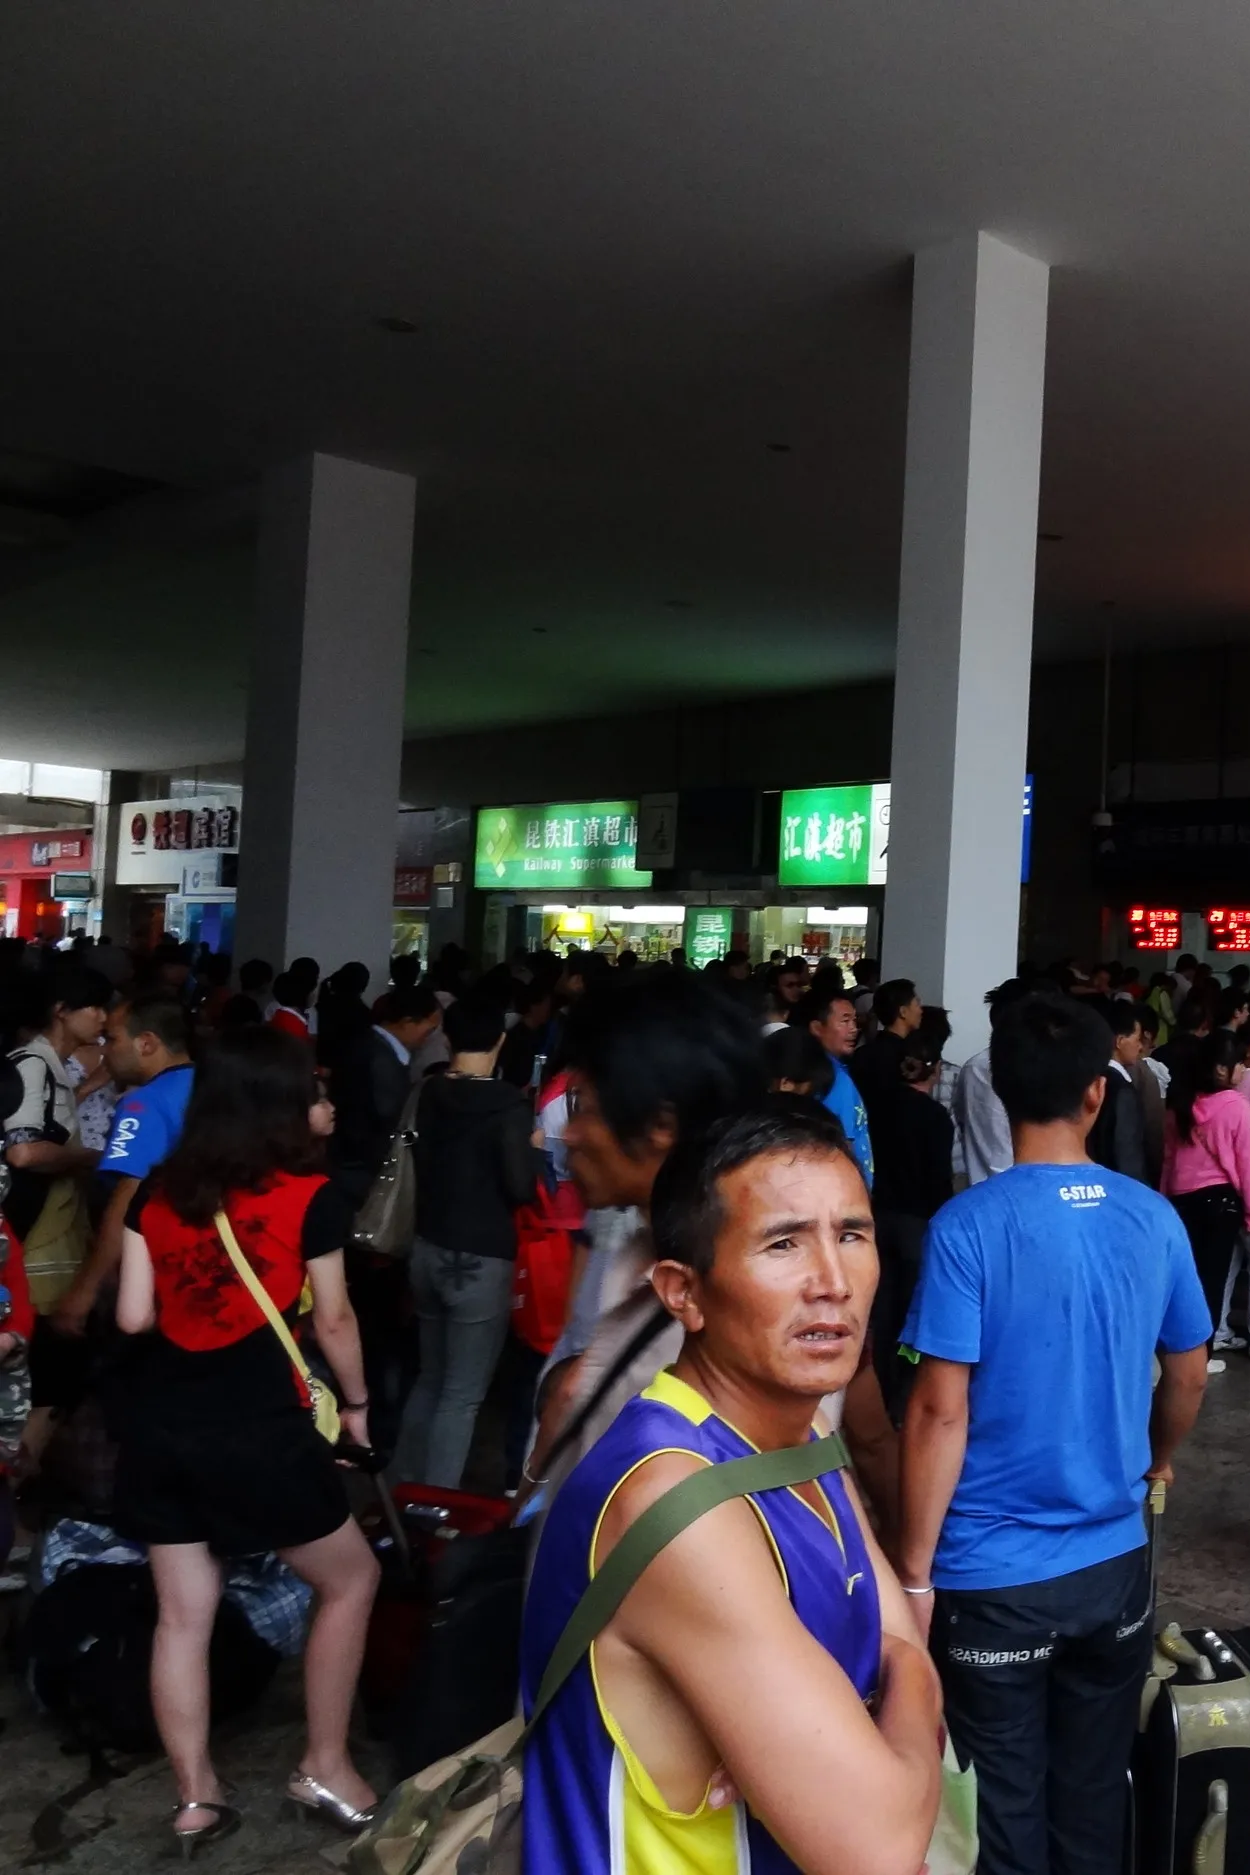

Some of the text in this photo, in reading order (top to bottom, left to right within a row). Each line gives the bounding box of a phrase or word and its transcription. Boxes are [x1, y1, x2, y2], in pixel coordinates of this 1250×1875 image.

[525, 816, 638, 848] 昆铁汇滇超市
[784, 811, 867, 863] 汇滇超市
[524, 857, 562, 872] Railway
